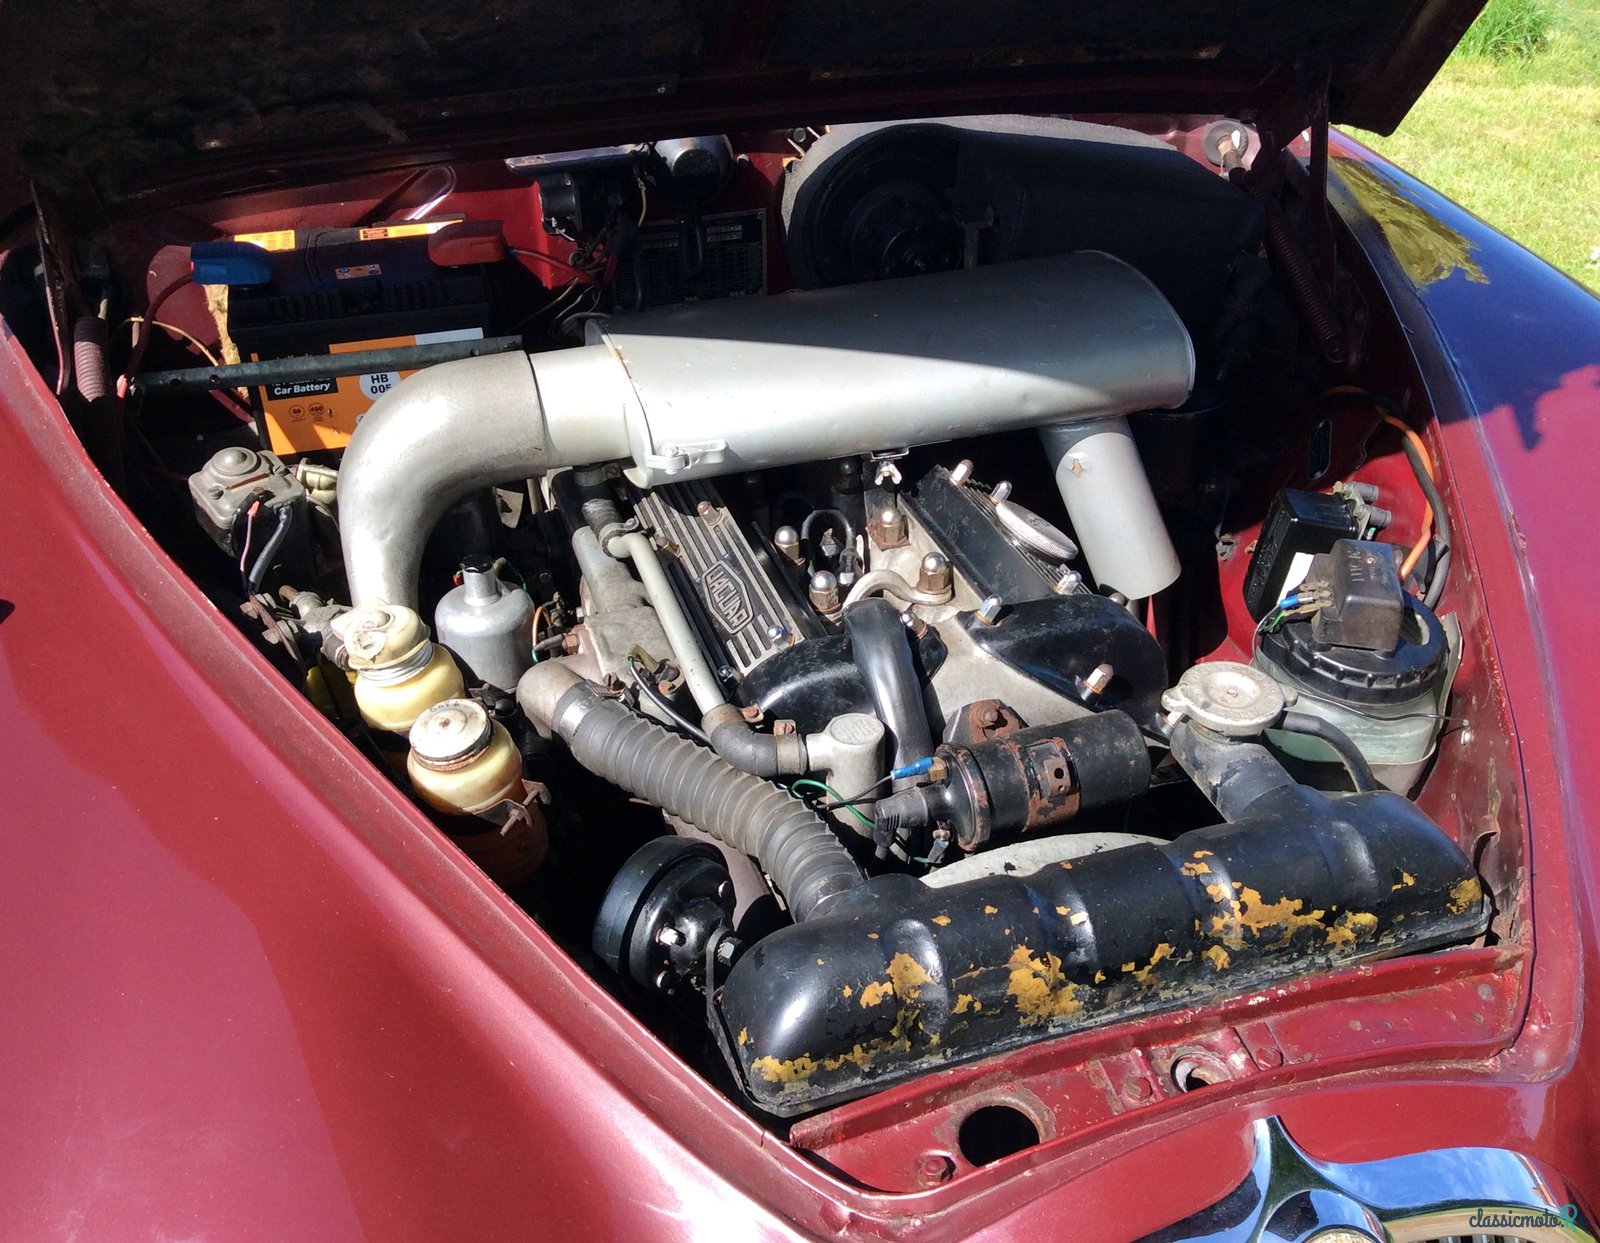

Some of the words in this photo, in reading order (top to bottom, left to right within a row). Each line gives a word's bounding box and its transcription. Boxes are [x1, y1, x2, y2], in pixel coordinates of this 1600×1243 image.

[371, 374, 388, 384] HB
[274, 387, 292, 395] Car
[293, 383, 331, 393] Battery
[705, 570, 749, 628] JAGUAR
